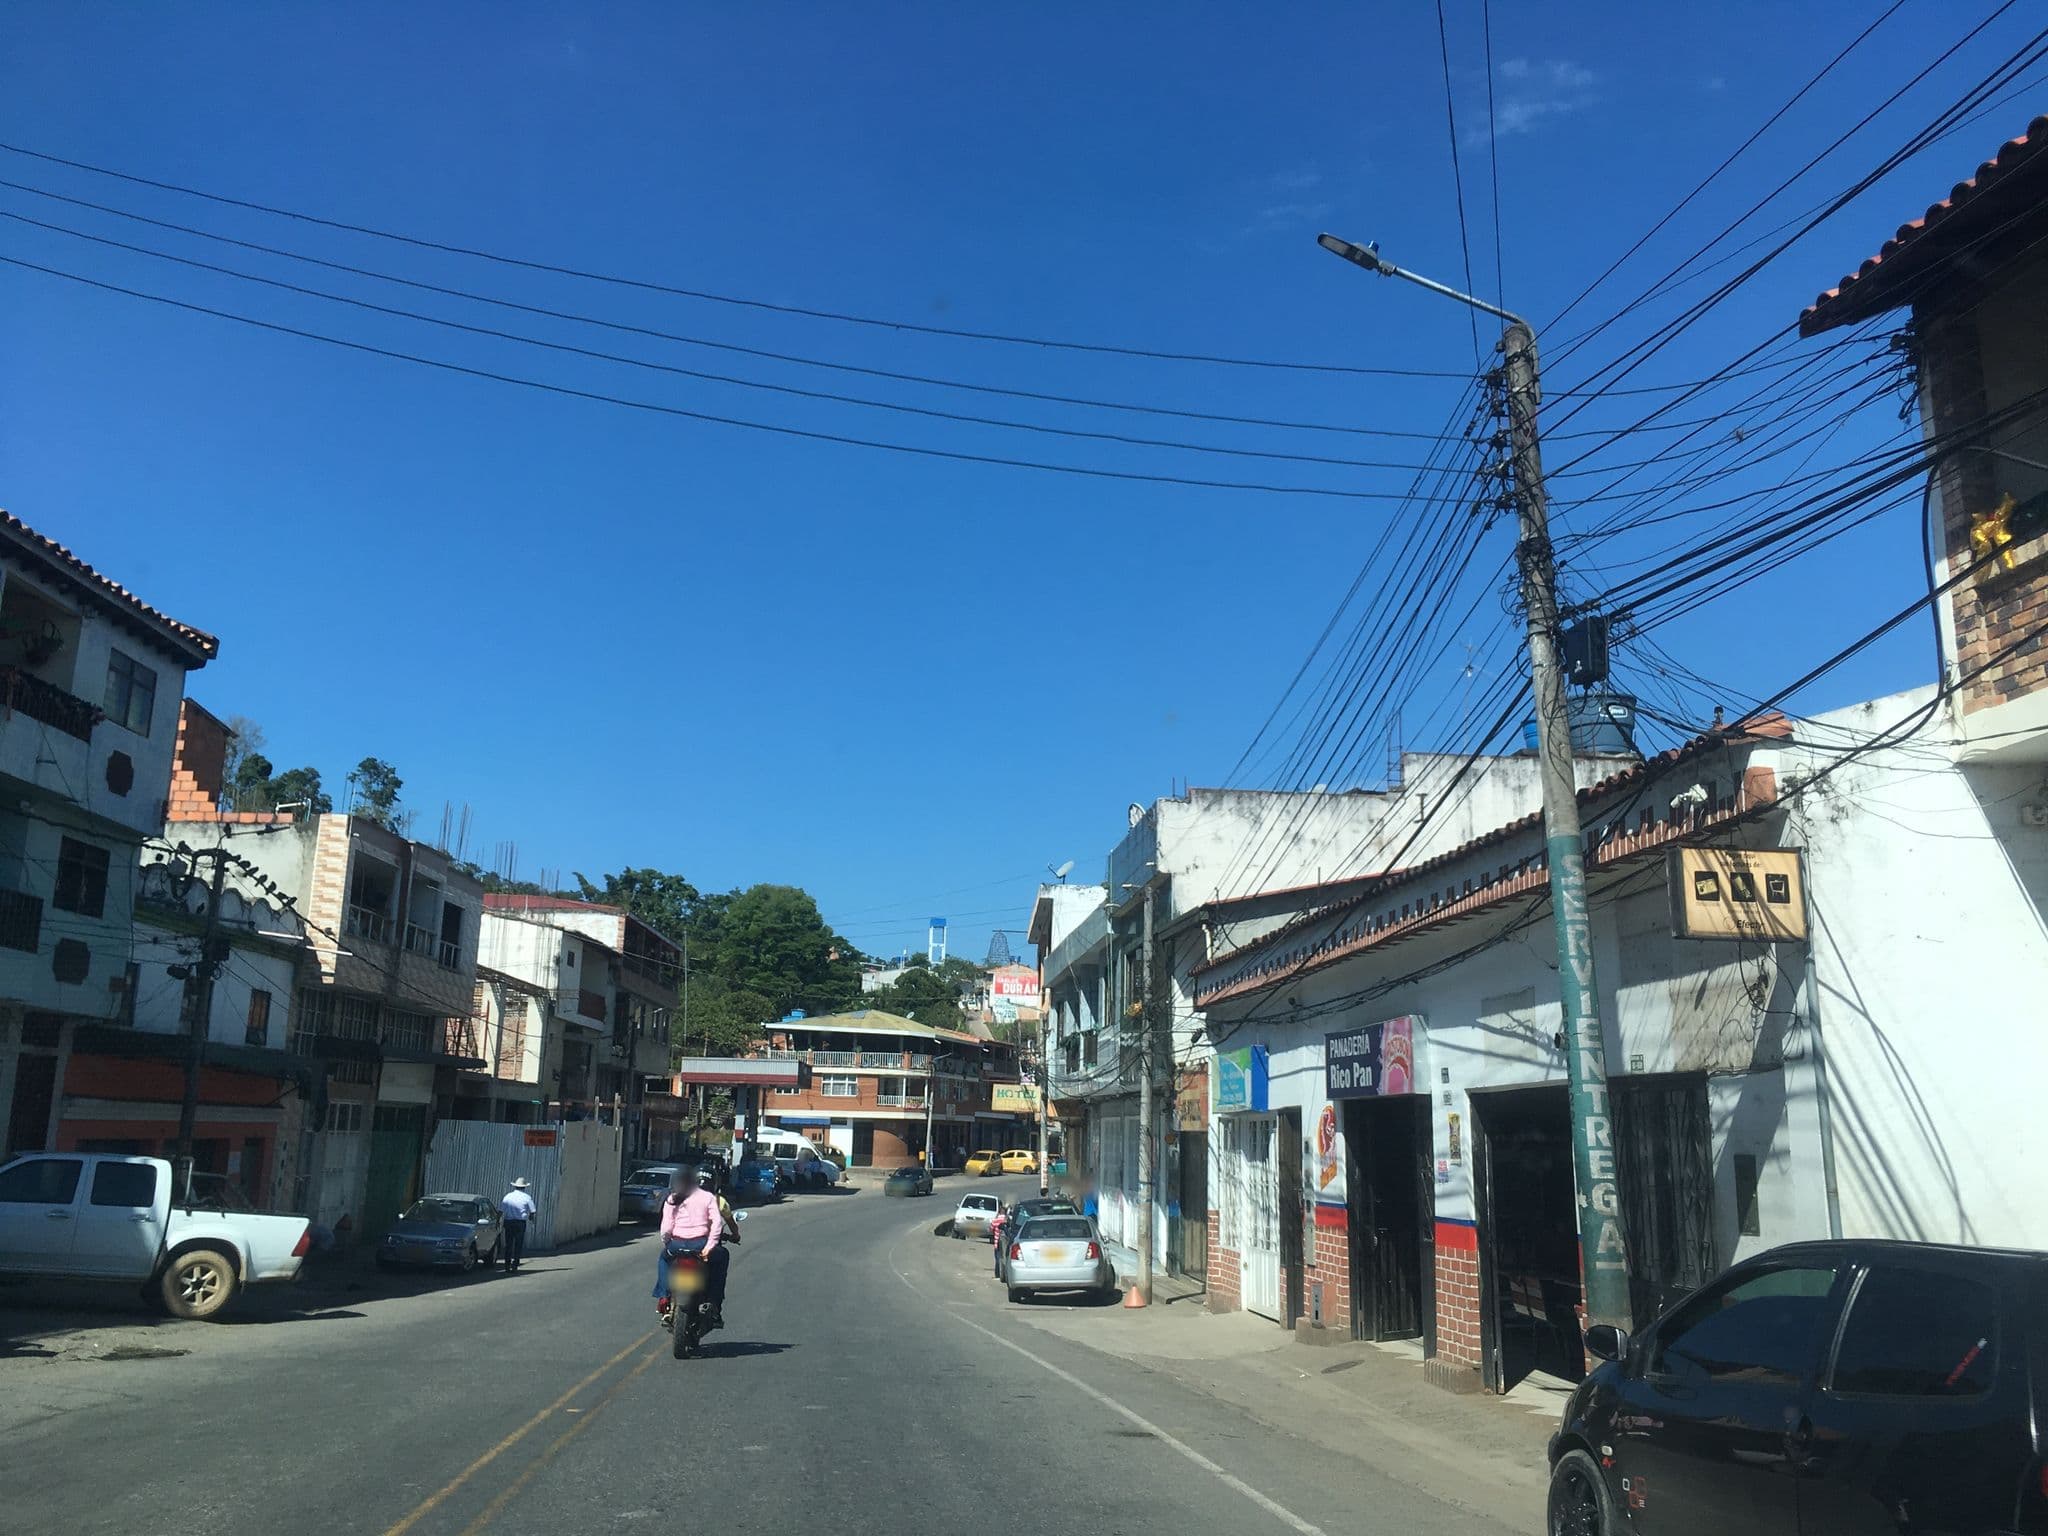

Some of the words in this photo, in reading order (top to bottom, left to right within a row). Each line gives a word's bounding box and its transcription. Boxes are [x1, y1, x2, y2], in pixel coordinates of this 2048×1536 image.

[1330, 1029, 1370, 1058] PANADERÍA
[1561, 855, 1625, 1254] SERVIENTREGA
[1330, 1064, 1351, 1089] Rico
[1353, 1062, 1373, 1087] Pan
[996, 1089, 1036, 1099] HOTEL
